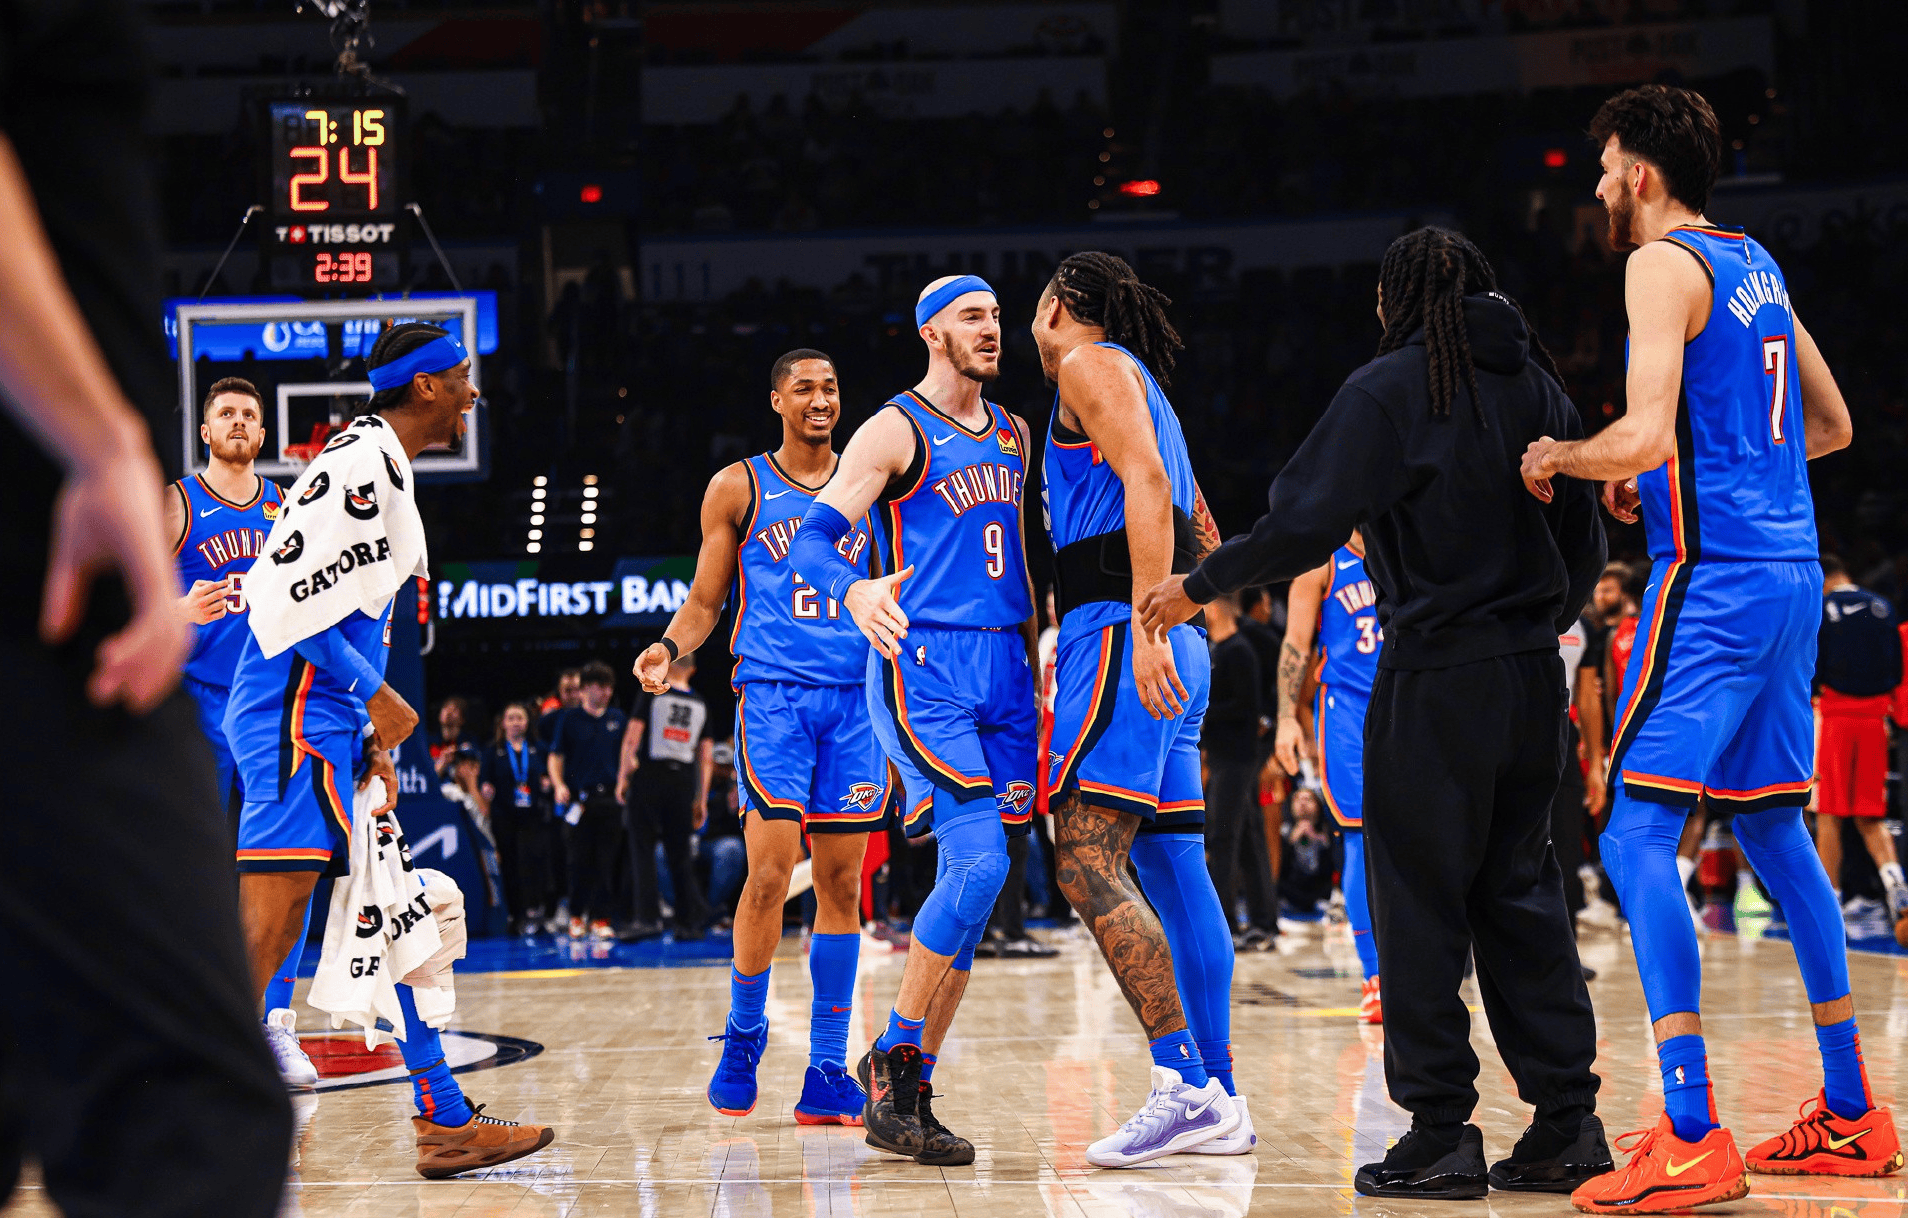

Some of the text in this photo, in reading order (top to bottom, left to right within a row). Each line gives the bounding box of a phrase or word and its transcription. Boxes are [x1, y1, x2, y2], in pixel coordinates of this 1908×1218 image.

[305, 109, 385, 146] 7:15
[289, 146, 379, 212] 24
[308, 223, 395, 244] TISSOT
[314, 252, 373, 283] 2:39
[1762, 333, 1788, 445] 7
[983, 521, 1006, 580] 9
[621, 575, 697, 614] BAN
[1334, 580, 1376, 615] THU
[1355, 616, 1384, 654] 3
[1004, 789, 1029, 804] OKC
